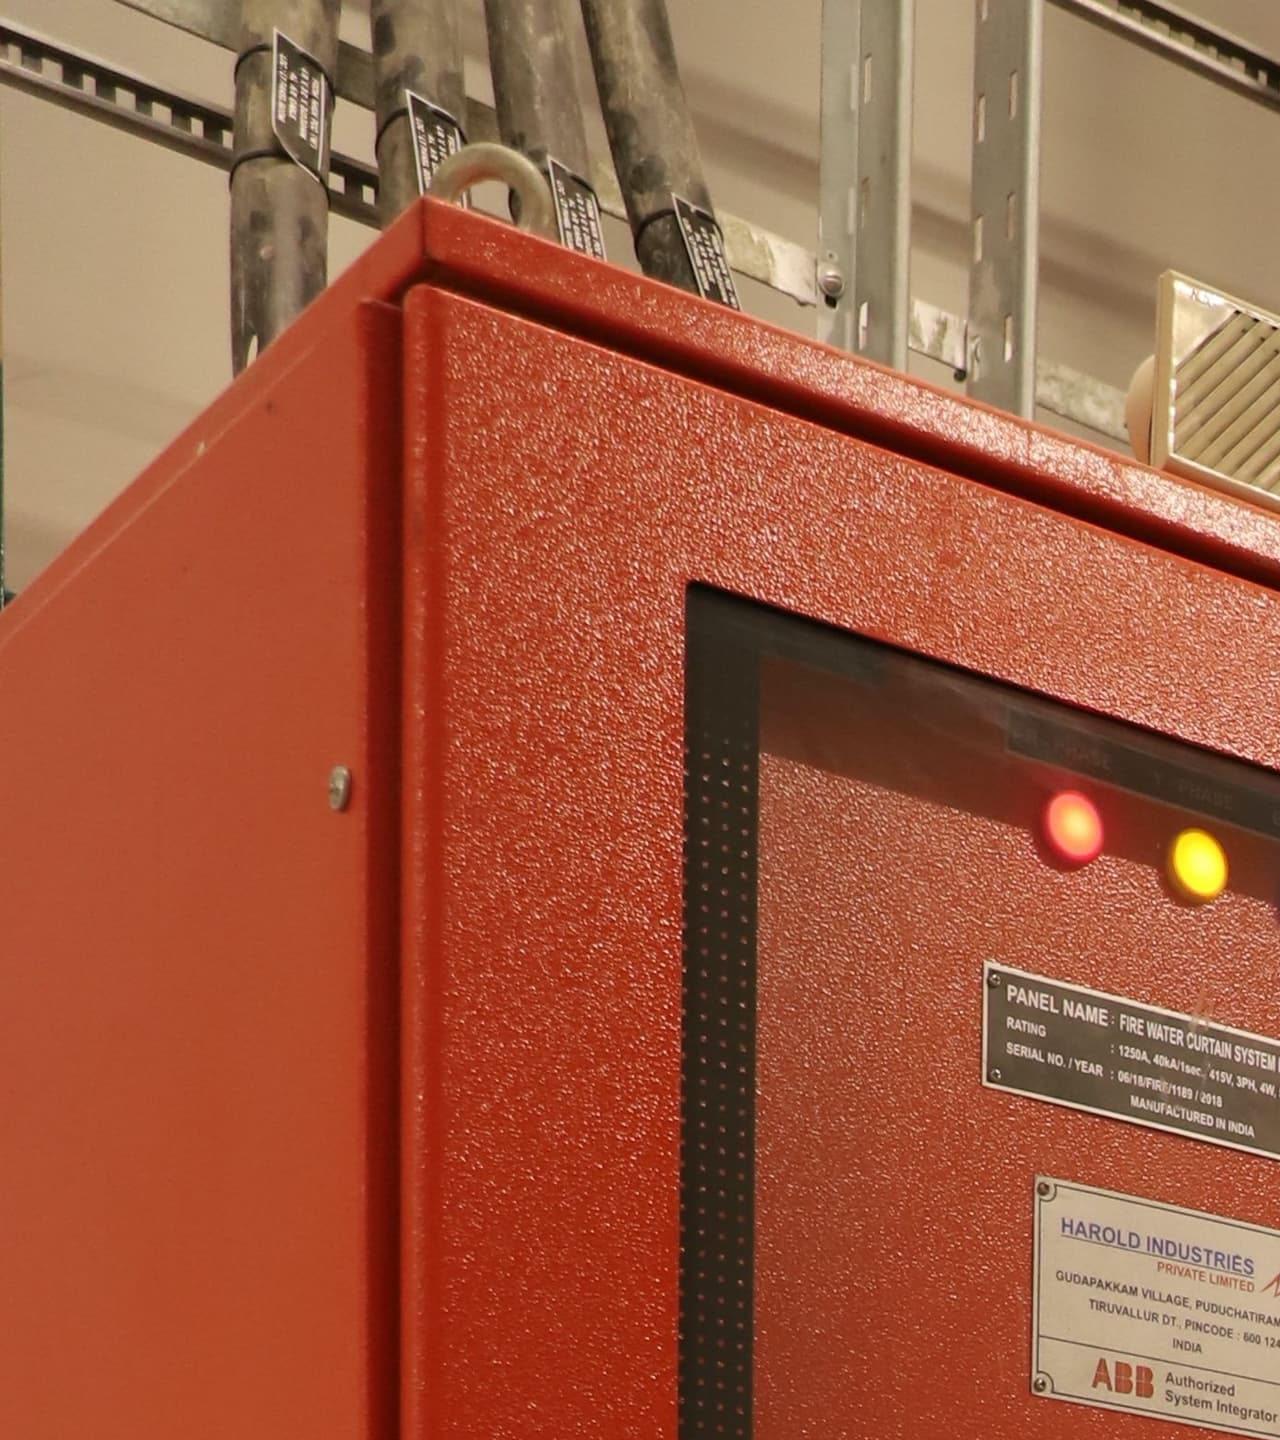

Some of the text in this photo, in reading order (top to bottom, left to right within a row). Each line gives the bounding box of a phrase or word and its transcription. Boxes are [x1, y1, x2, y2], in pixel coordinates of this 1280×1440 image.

[1006, 1016, 1046, 1037] RATING
[1007, 984, 1059, 1013] PANEL
[1063, 999, 1109, 1026] NAME
[1119, 1013, 1144, 1036] FIRE
[1147, 1021, 1184, 1047] WATER
[1186, 1032, 1232, 1060] CURTAIN
[1234, 1045, 1276, 1072] SYSTEM
[1006, 1041, 1045, 1063] SERIAL
[1047, 1052, 1066, 1068] NO.
[1074, 1060, 1103, 1077] YEAR
[1201, 1092, 1222, 1108] 2018
[1236, 1075, 1258, 1093] 3PH,
[1260, 1082, 1276, 1098] 4W,
[1130, 1095, 1255, 1138] MANUFACTURED IN INDIA
[1061, 1217, 1255, 1275] HAROLD INDUSTRIES
[1056, 1270, 1138, 1297] GUDAPAKKAM
[1157, 1261, 1255, 1293] PRIVATE LIMITED
[1089, 1299, 1160, 1323] TIRUVALLUR
[1184, 1319, 1233, 1340] PINCODE
[1172, 1338, 1202, 1353] INDIA
[1092, 1358, 1154, 1399] ABB
[1165, 1371, 1235, 1397] Authorized
[1165, 1390, 1278, 1424] System Integrator
